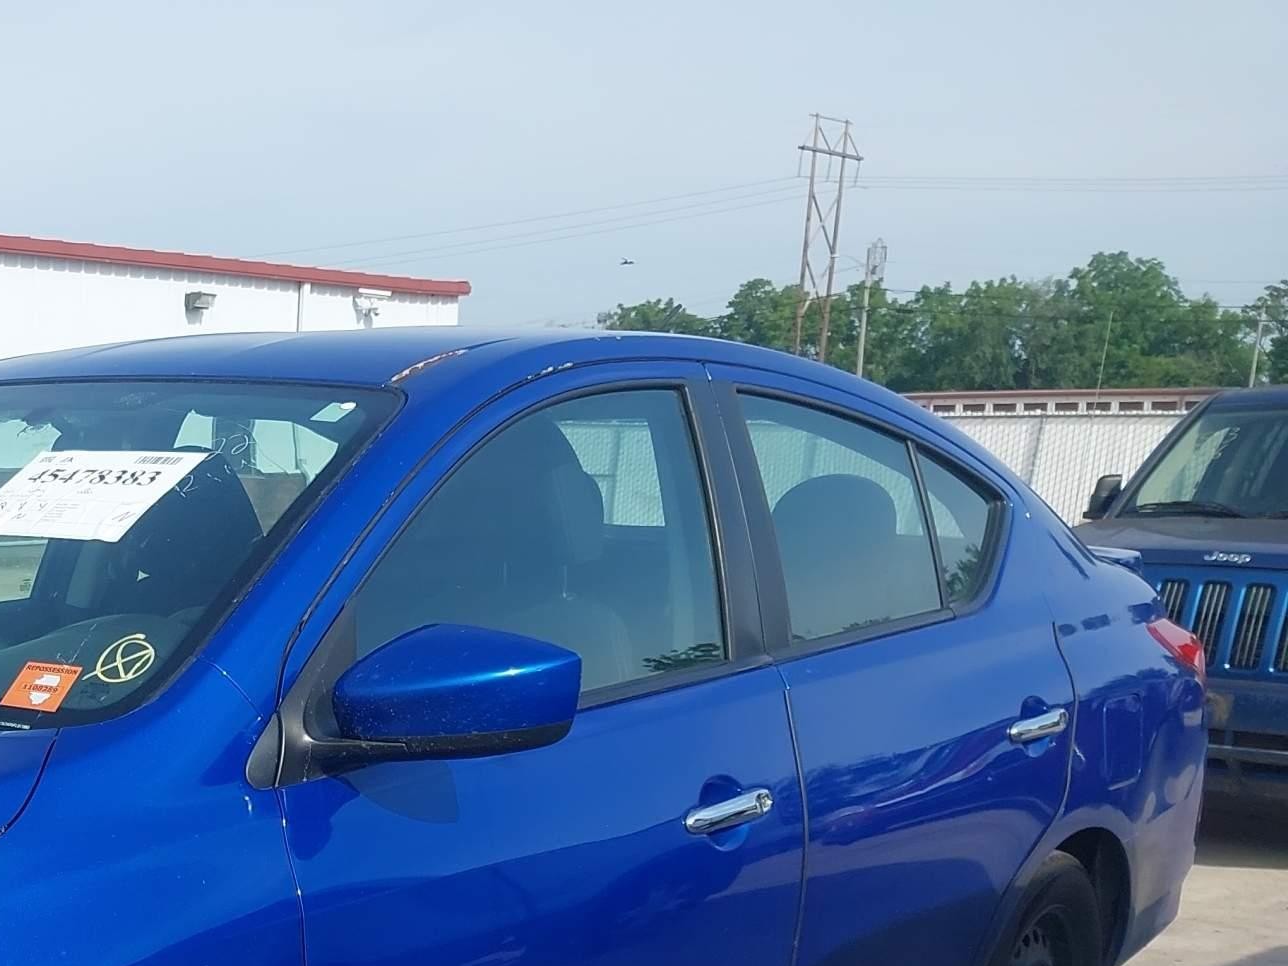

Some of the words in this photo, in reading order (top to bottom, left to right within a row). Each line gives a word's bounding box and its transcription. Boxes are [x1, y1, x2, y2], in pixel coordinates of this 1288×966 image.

[28, 468, 162, 487] 45478383
[1203, 551, 1251, 564] Jeep
[25, 664, 79, 676] REPOSSESSION
